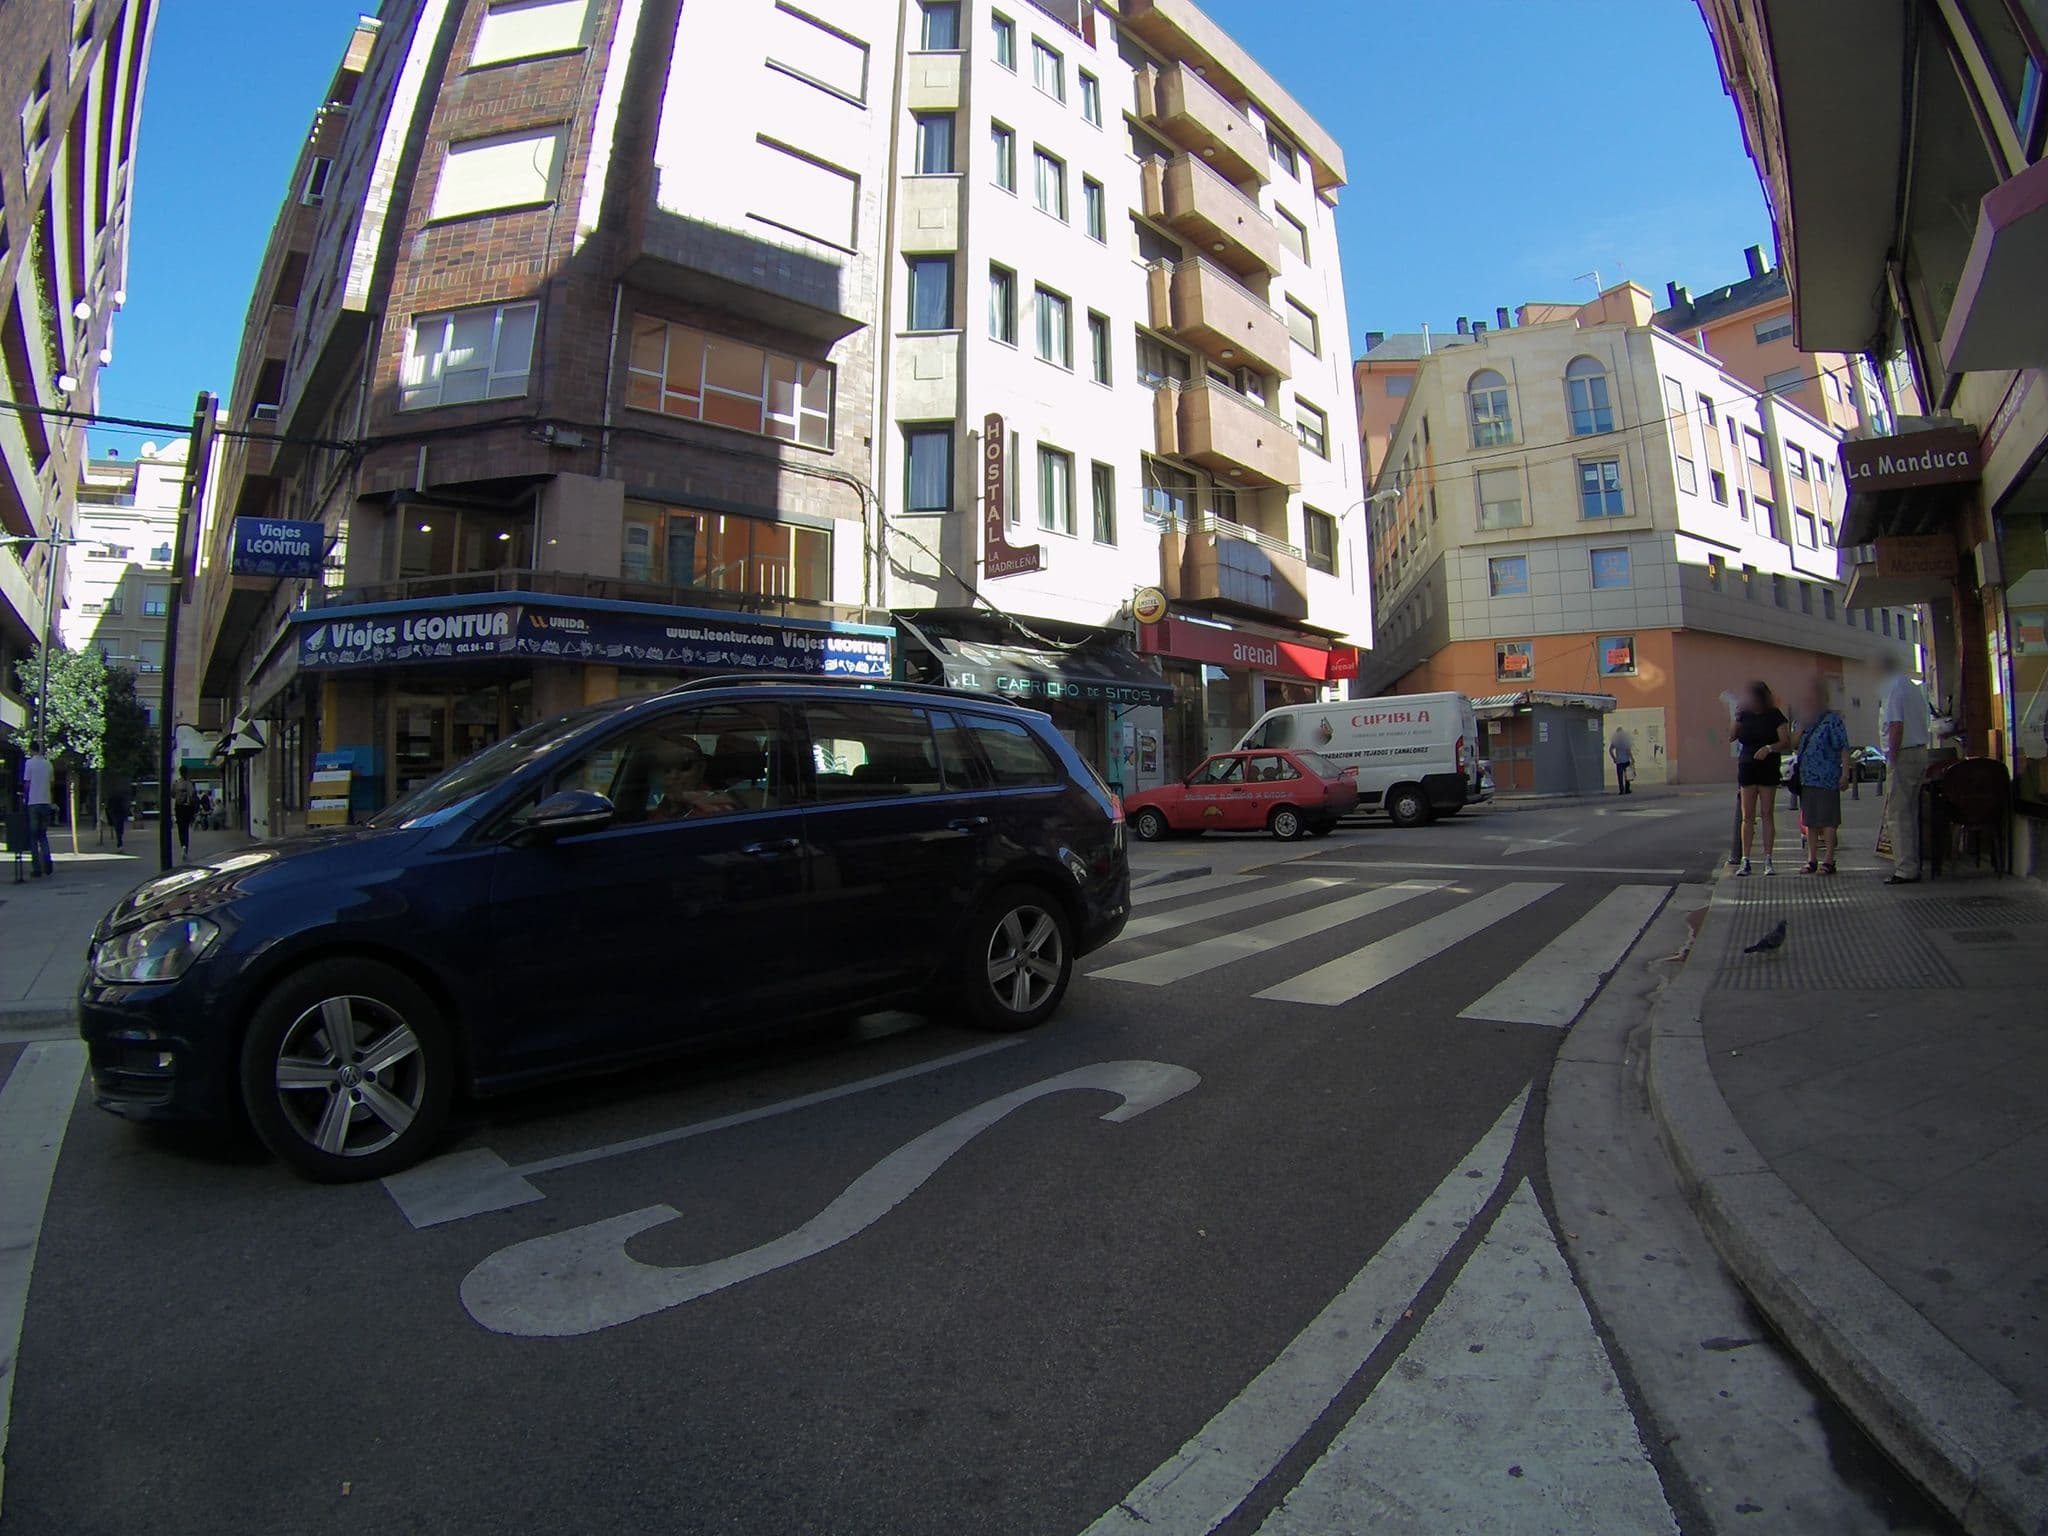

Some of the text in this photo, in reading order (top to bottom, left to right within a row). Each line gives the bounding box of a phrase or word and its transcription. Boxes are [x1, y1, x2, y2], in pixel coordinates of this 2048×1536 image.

[1847, 450, 1969, 480] La Manduca
[986, 422, 1000, 544] HOSTAL
[259, 523, 302, 540] Viajes
[246, 539, 310, 556] LEONTUR
[988, 551, 999, 562] LA
[988, 554, 1037, 574] MADRILEÑA
[331, 611, 510, 650] Viajes LEONTUR
[666, 626, 774, 647] www.leontur.com
[782, 631, 826, 654] Viajes
[1233, 641, 1278, 666] arenal
[1330, 661, 1355, 671] arenal
[961, 672, 1151, 700] EL CAPRICHO DE SITOS
[1351, 710, 1430, 728] CUPIBLA
